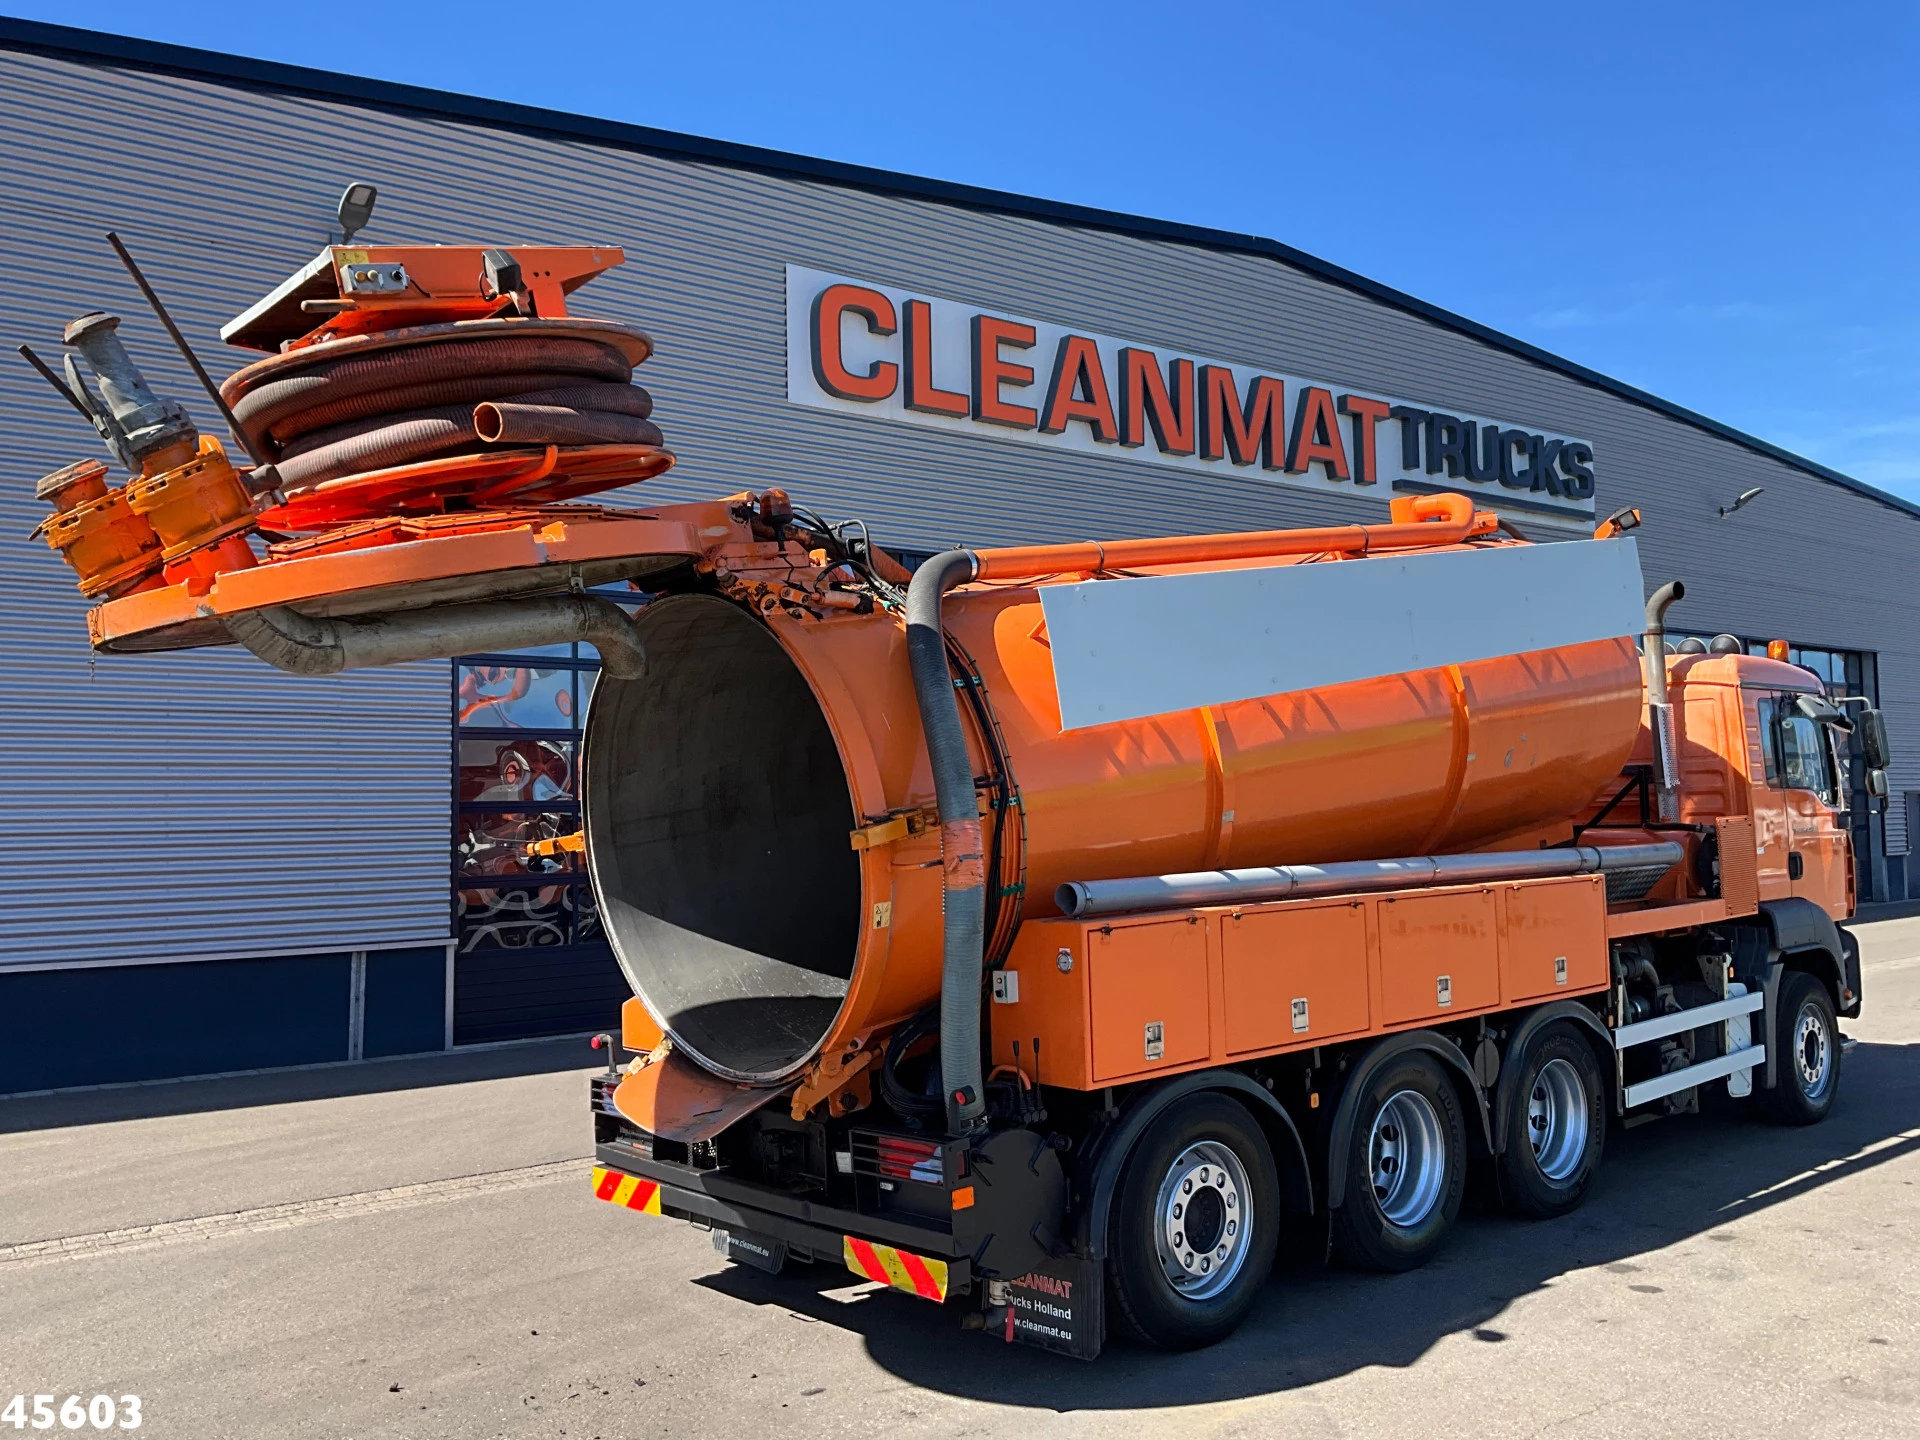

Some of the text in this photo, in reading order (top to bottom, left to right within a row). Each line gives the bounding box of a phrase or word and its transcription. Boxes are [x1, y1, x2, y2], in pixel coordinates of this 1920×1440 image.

[810, 283, 1595, 500] CLEANMAT TRUCKS
[1011, 1296, 1072, 1320] ucks Holland
